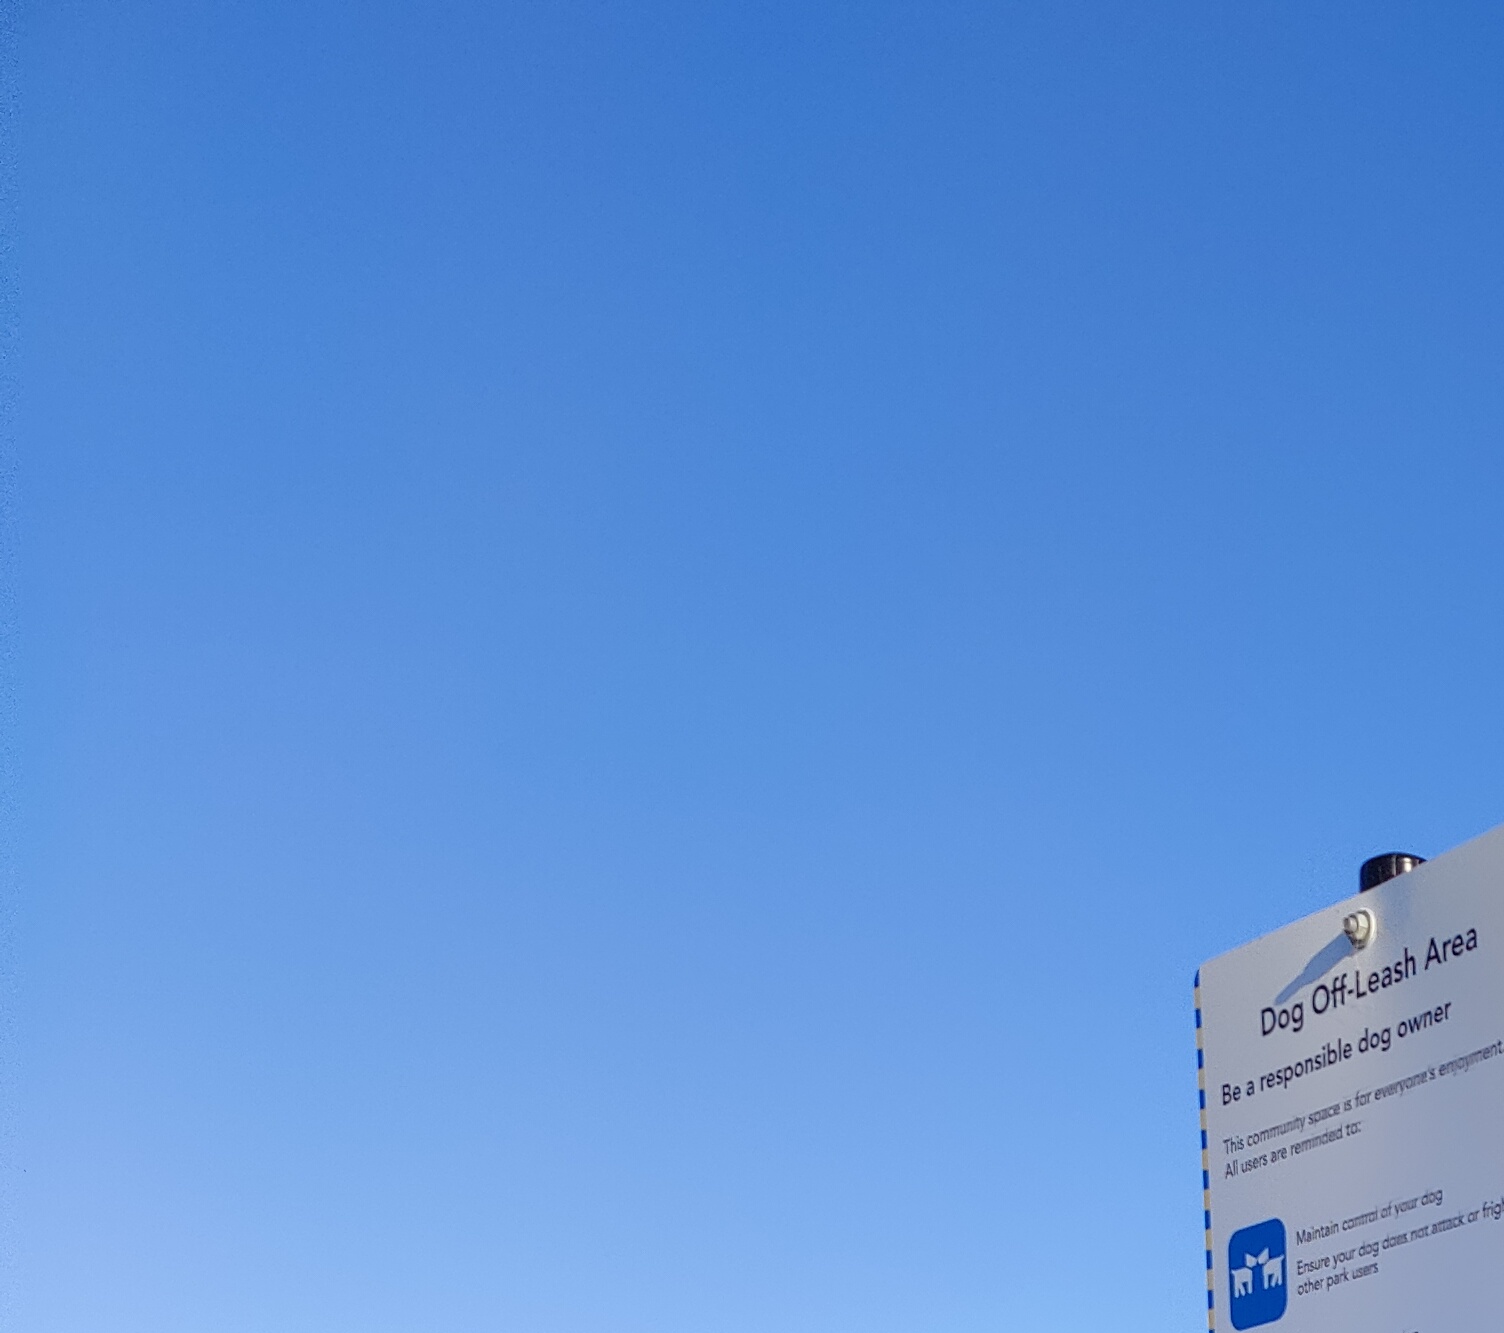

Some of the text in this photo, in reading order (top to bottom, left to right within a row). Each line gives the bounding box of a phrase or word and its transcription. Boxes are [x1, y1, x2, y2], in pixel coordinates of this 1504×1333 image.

[1261, 927, 1478, 1036] Dog Off-Leash Area
[1222, 1002, 1452, 1106] Be a responsible dog owner
[1222, 1135, 1245, 1155] This
[1247, 1115, 1306, 1147] community
[1308, 1103, 1341, 1126] space
[1343, 1096, 1353, 1111] is
[1354, 1089, 1372, 1108] for
[1374, 1067, 1436, 1101] everyone's
[1224, 1159, 1239, 1180] All
[1240, 1153, 1268, 1174] users
[1270, 1147, 1288, 1164] are
[1290, 1124, 1344, 1157] reminded
[1296, 1189, 1443, 1246] Maintain control of your dog
[1296, 1256, 1331, 1276] Ensure
[1332, 1248, 1357, 1270] your
[1358, 1240, 1380, 1257] dog
[1382, 1232, 1409, 1250] does
[1410, 1225, 1430, 1241] not
[1431, 1214, 1465, 1235] attack
[1467, 1210, 1480, 1223] or
[1297, 1262, 1379, 1296] other park users
